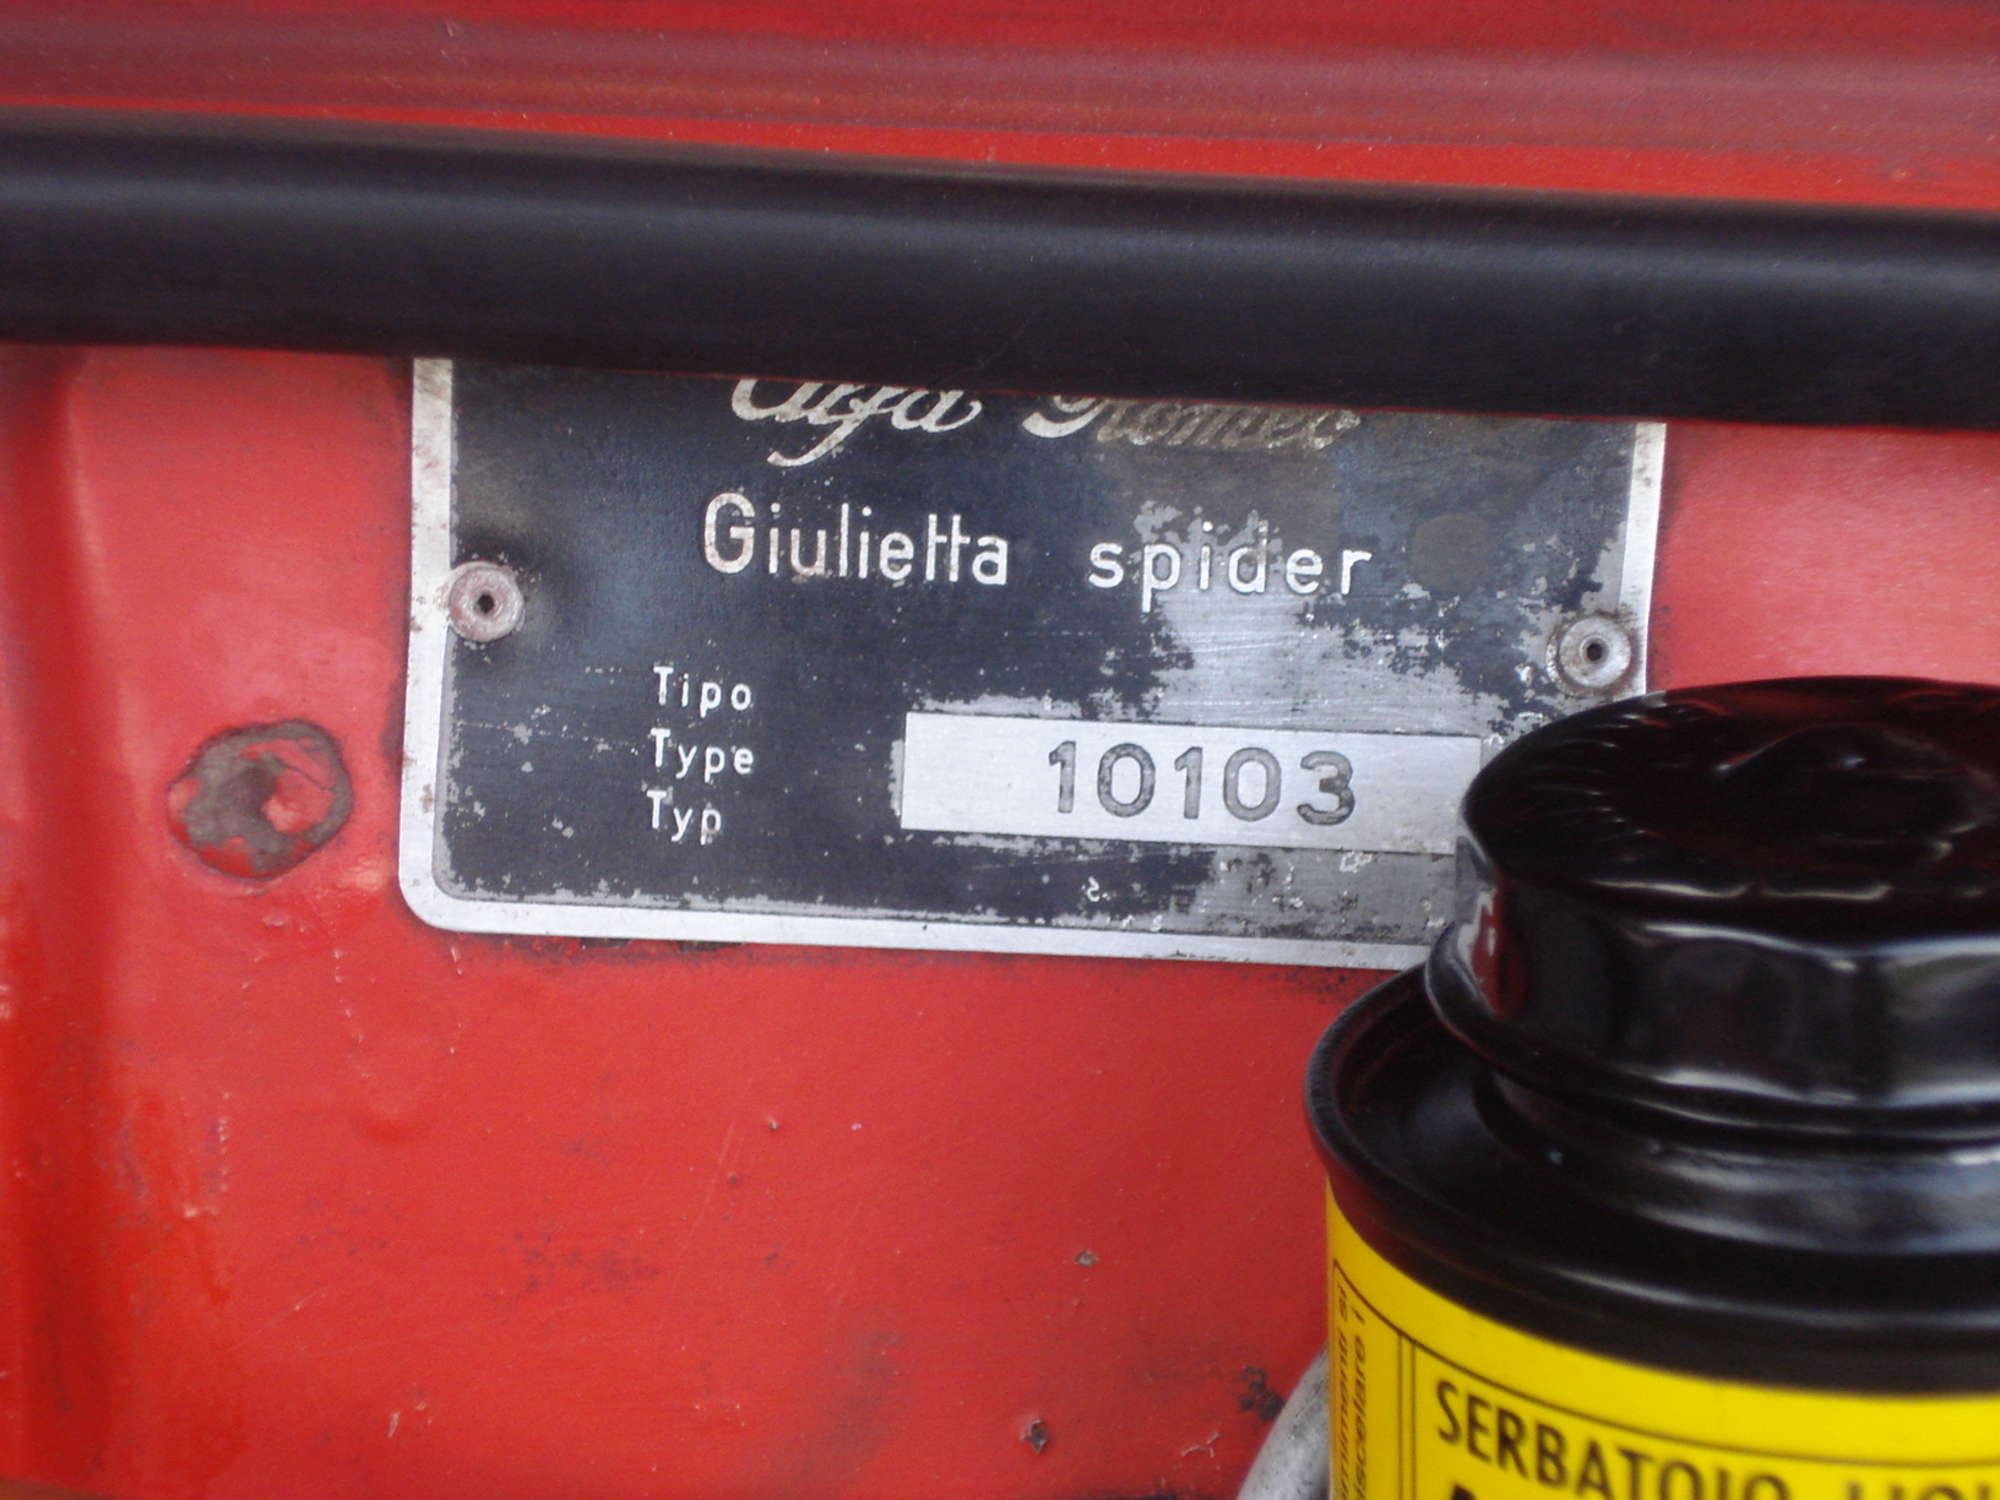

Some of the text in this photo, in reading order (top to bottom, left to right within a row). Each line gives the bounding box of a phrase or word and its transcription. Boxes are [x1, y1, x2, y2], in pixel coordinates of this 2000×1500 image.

[704, 492, 1373, 613] Giulietta spider
[653, 666, 752, 717] Tipo
[650, 728, 754, 783] Type
[1048, 740, 1355, 826] 10103
[646, 790, 722, 845] Typ
